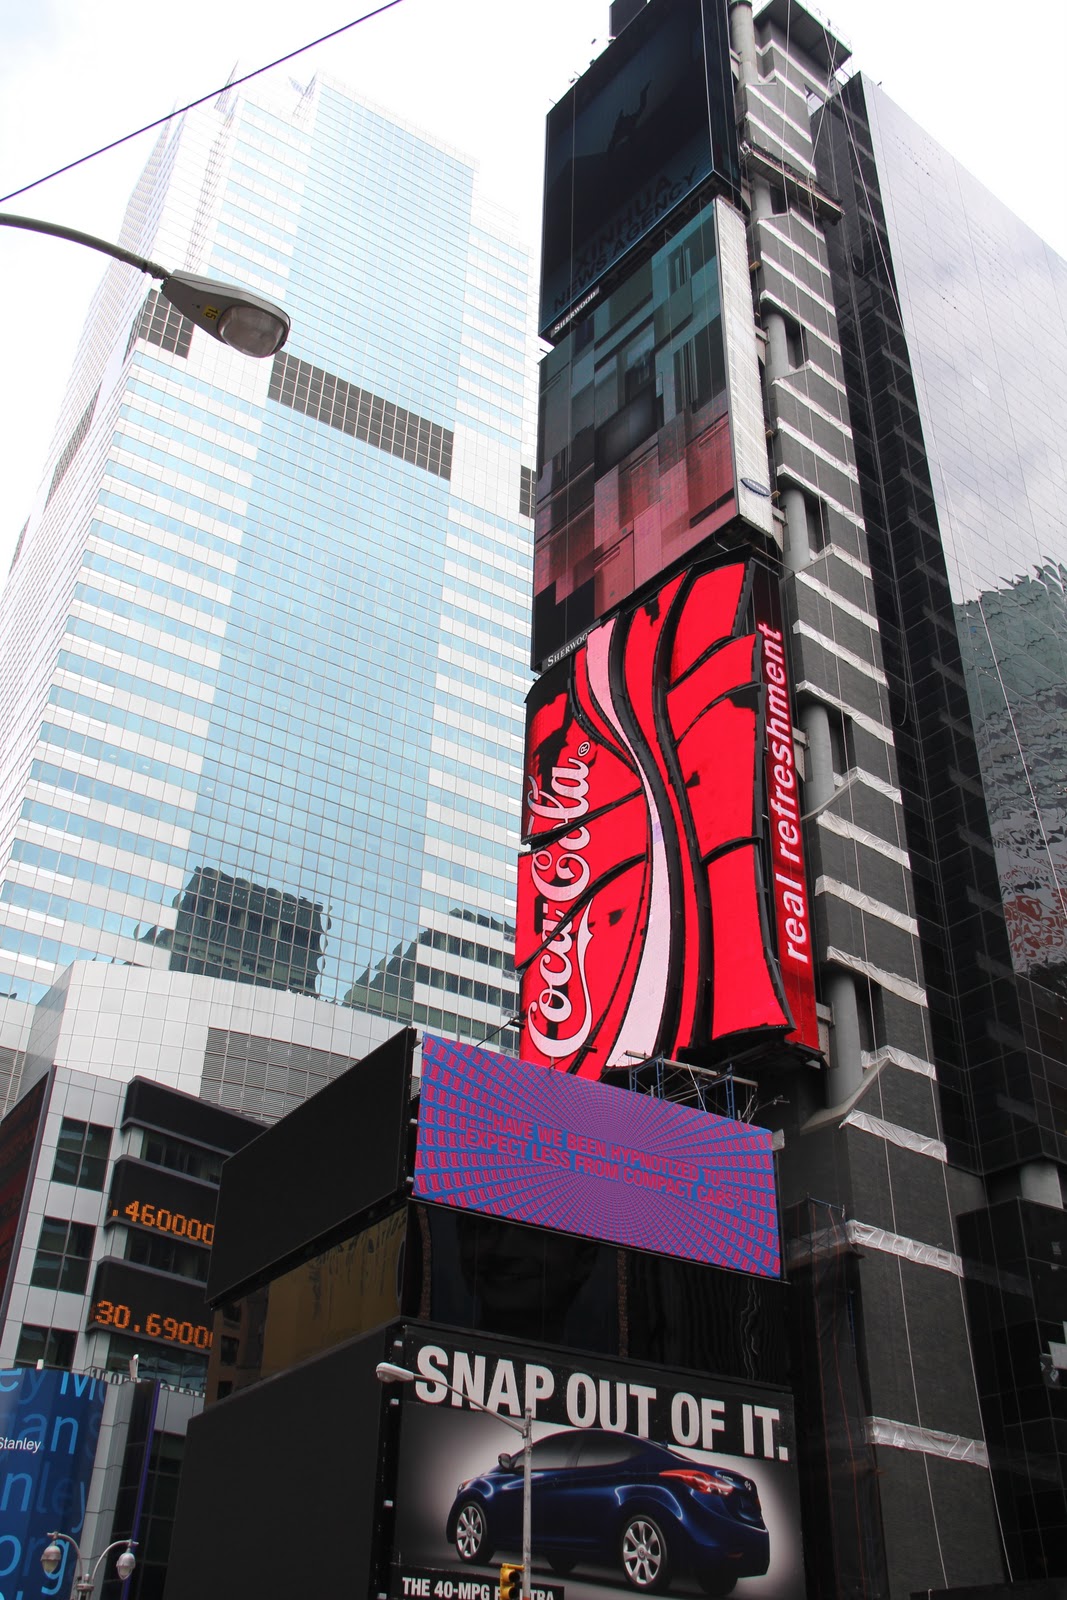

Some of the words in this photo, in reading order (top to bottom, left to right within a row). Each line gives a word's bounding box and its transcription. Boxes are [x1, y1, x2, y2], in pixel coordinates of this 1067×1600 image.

[554, 256, 607, 312] NEWS
[612, 165, 697, 260] AGENCY
[574, 175, 672, 273] XINHUA
[207, 307, 220, 321] 15
[547, 628, 593, 667] SHERWOO
[758, 622, 801, 864] refreshment
[775, 872, 809, 964] real
[466, 1127, 528, 1158] EXPECT
[531, 1143, 571, 1169] LESS
[575, 1153, 619, 1180] FROM
[623, 1165, 693, 1199] COMPACT
[697, 1185, 742, 1211] CARS?
[493, 1113, 534, 1140] HAVE
[538, 1124, 563, 1148] WE
[567, 1132, 607, 1158] BEEN
[610, 1143, 699, 1182] HYPNOTIZED
[702, 1167, 721, 1187] TO
[415, 1344, 555, 1420] SNAP
[566, 1372, 657, 1439] OUT
[671, 1391, 726, 1451] OF
[742, 1403, 789, 1462] IT.
[402, 1576, 431, 1597] THE
[434, 1580, 491, 1600] 40-MPG
